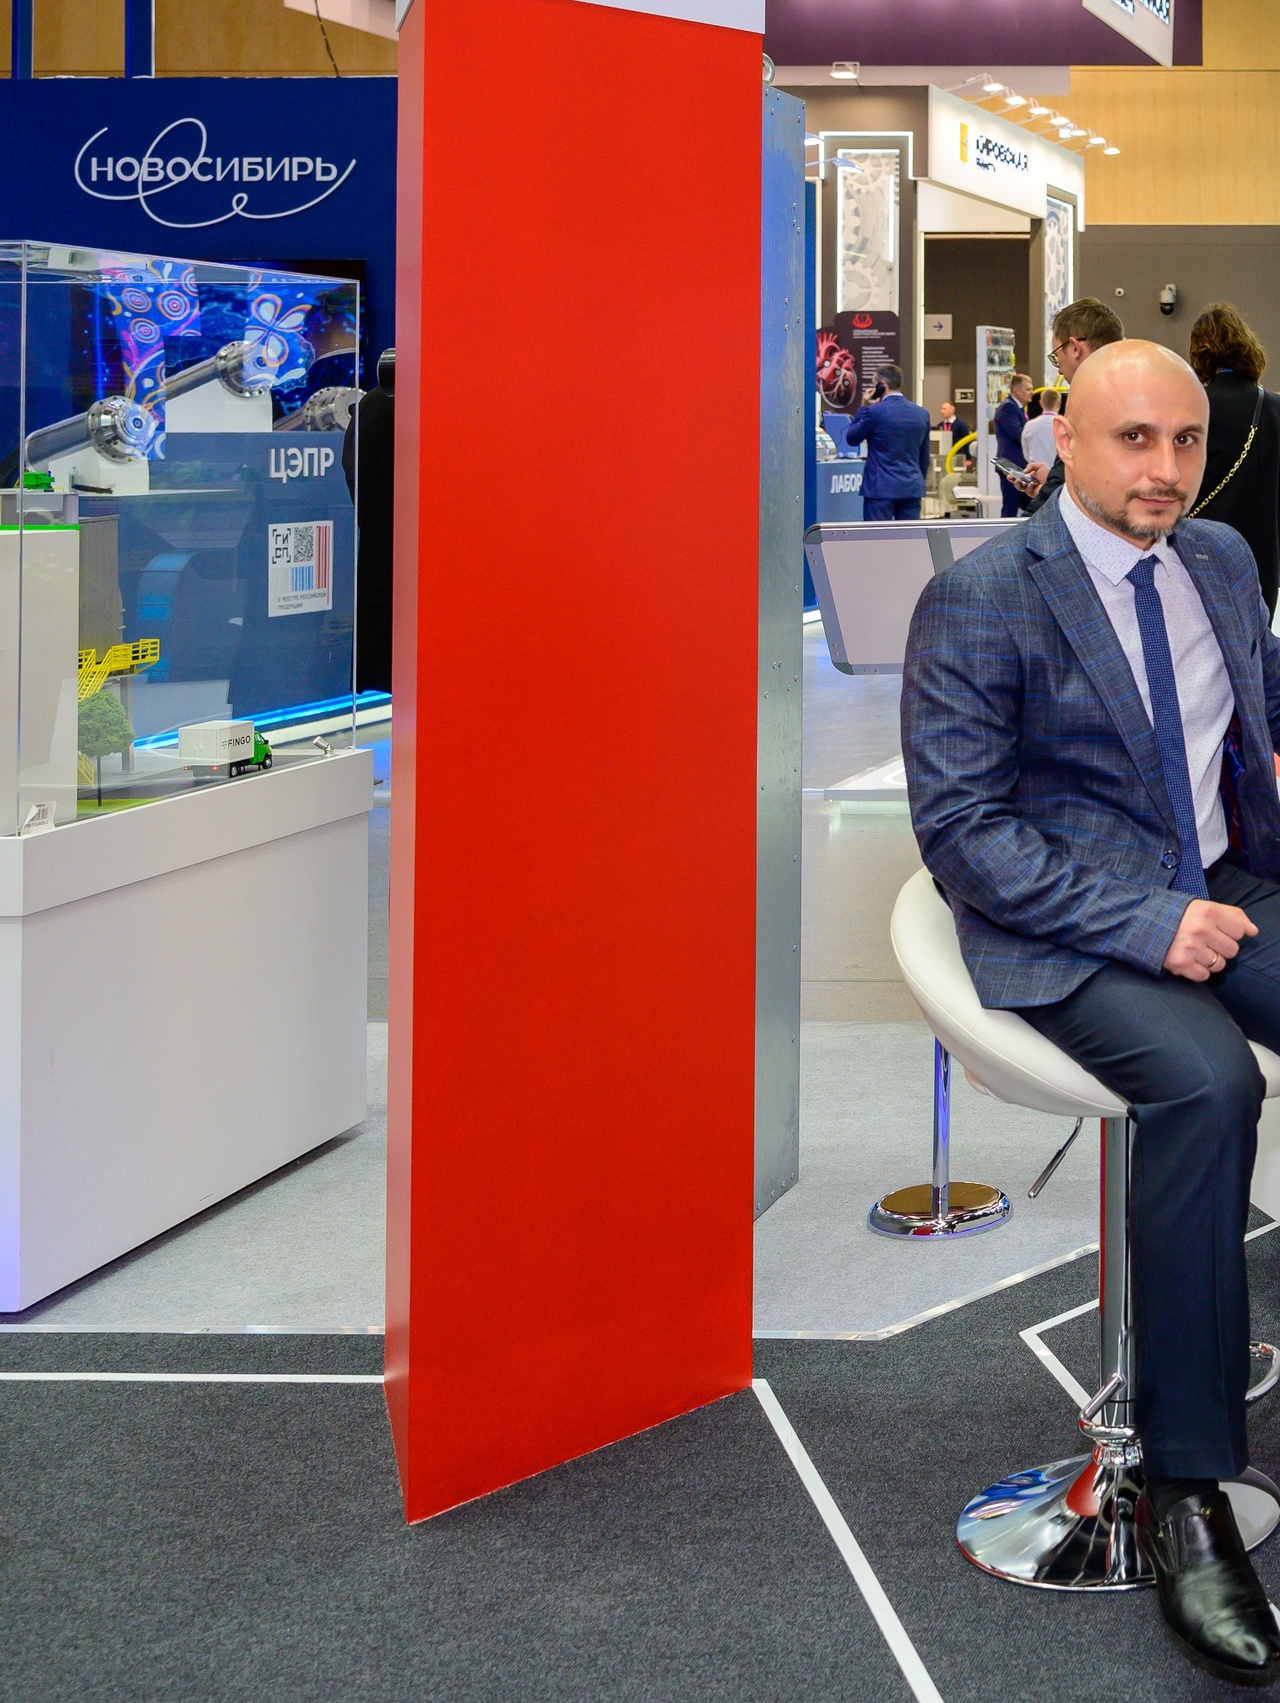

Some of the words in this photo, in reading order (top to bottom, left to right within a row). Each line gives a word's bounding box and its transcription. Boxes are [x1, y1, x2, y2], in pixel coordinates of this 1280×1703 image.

[91, 157, 338, 182] НОВОСИБИРЬ
[269, 447, 335, 484] ЦЭПР
[830, 473, 863, 494] ЛАБОР
[227, 735, 251, 748] FINGO
